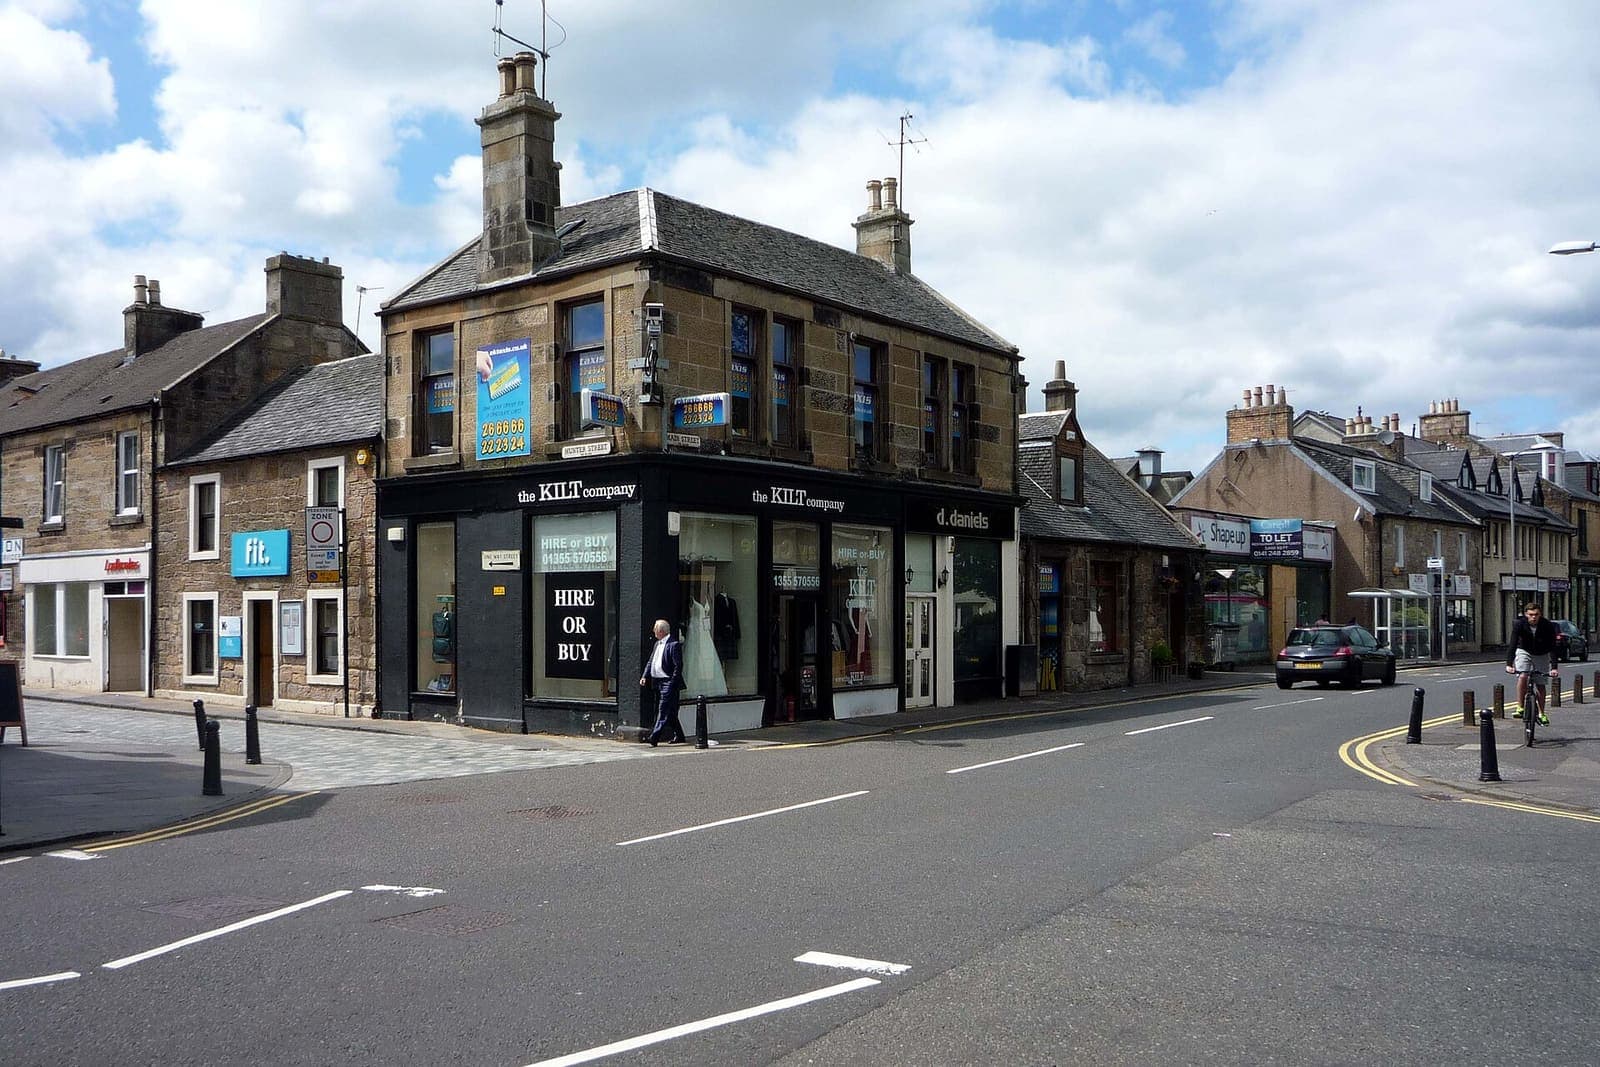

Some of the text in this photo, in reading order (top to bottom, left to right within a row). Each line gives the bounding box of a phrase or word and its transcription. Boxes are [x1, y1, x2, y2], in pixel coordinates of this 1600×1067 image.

[587, 443, 608, 453] STREET
[518, 480, 636, 503] the KILT company
[752, 486, 845, 513] the KILT company
[311, 512, 334, 520] ZONE
[541, 535, 608, 550] HIRE or BUY
[1210, 522, 1247, 551] Shape up
[1259, 533, 1293, 543] TO LET
[245, 538, 270, 565] fit.
[838, 547, 857, 559] HIRE
[869, 549, 886, 560] BUY
[554, 589, 595, 607] HIRE
[562, 616, 587, 634] OR
[558, 643, 592, 661] BUY
